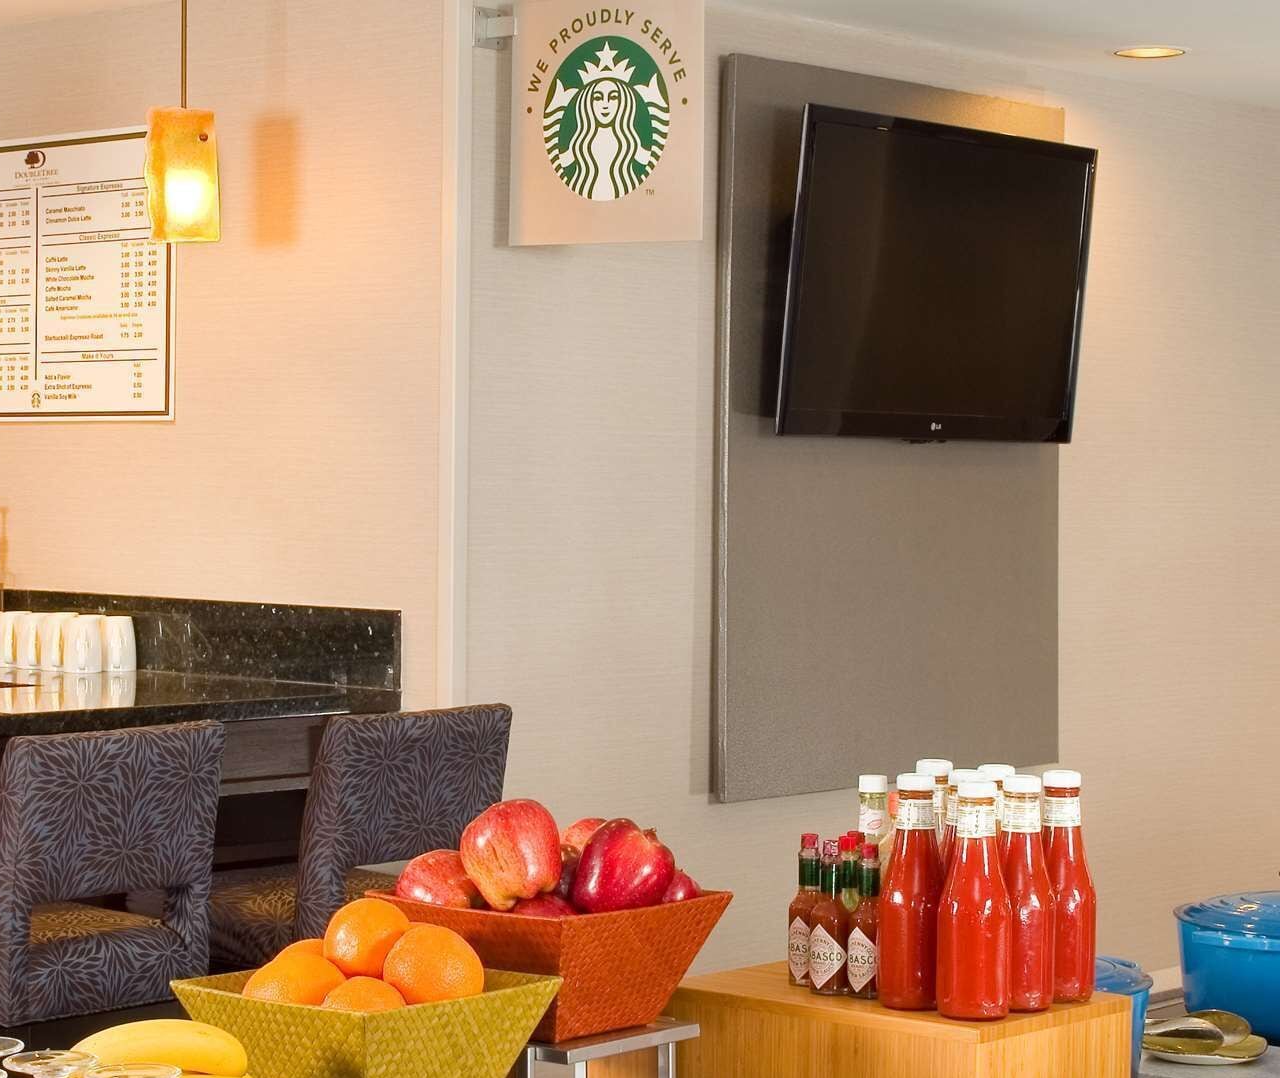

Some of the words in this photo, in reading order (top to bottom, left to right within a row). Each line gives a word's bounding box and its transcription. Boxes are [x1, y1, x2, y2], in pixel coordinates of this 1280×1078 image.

[527, 59, 549, 93] WE
[549, 9, 634, 54] PROUDLY
[641, 19, 686, 82] SERVE
[77, 185, 99, 193] Signature
[810, 951, 842, 961] BASCO
